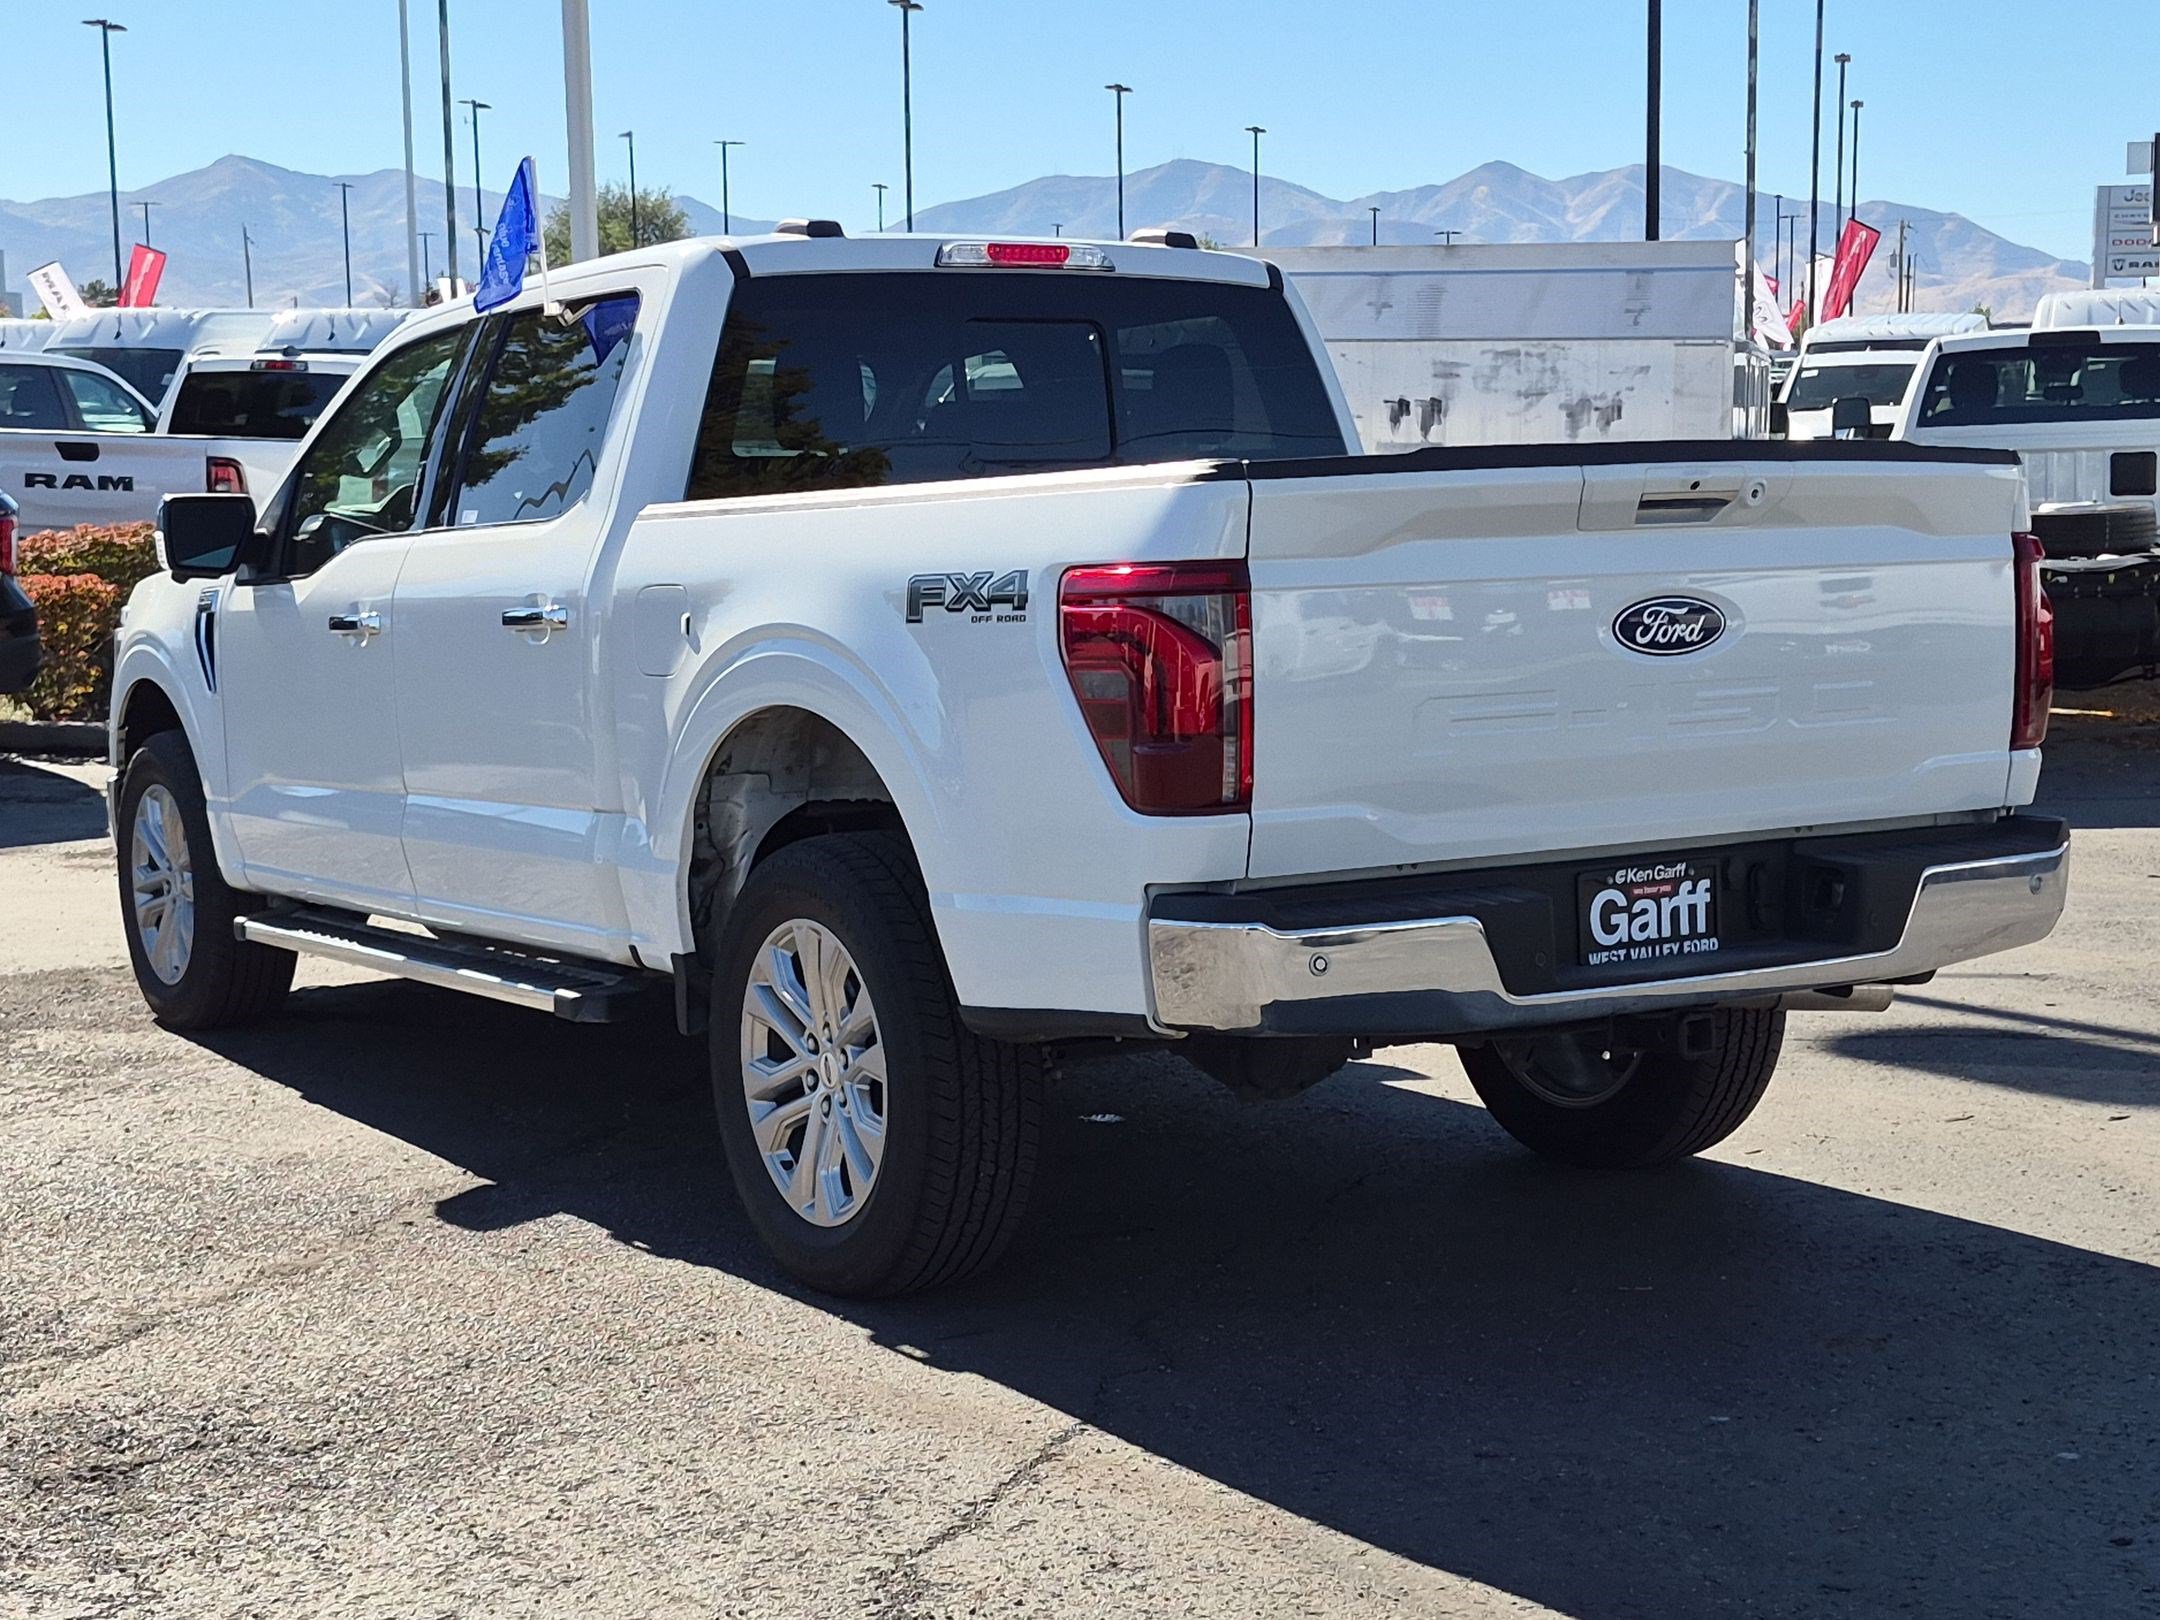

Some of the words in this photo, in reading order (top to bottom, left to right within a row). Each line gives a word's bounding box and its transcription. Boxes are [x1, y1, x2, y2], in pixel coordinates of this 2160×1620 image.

[2112, 239, 2152, 247] DOD
[24, 473, 134, 492] RAM
[906, 569, 1029, 624] FX4
[970, 615, 993, 624] OFF
[996, 614, 1027, 623] ROAD
[1635, 606, 1706, 644] Ford
[1627, 867, 1652, 883] Ken
[1654, 862, 1687, 880] Garff
[1589, 878, 1711, 946] Garff
[1588, 949, 1627, 966] WEST
[1630, 942, 1681, 960] VALLEY
[1683, 937, 1719, 954] FORD
